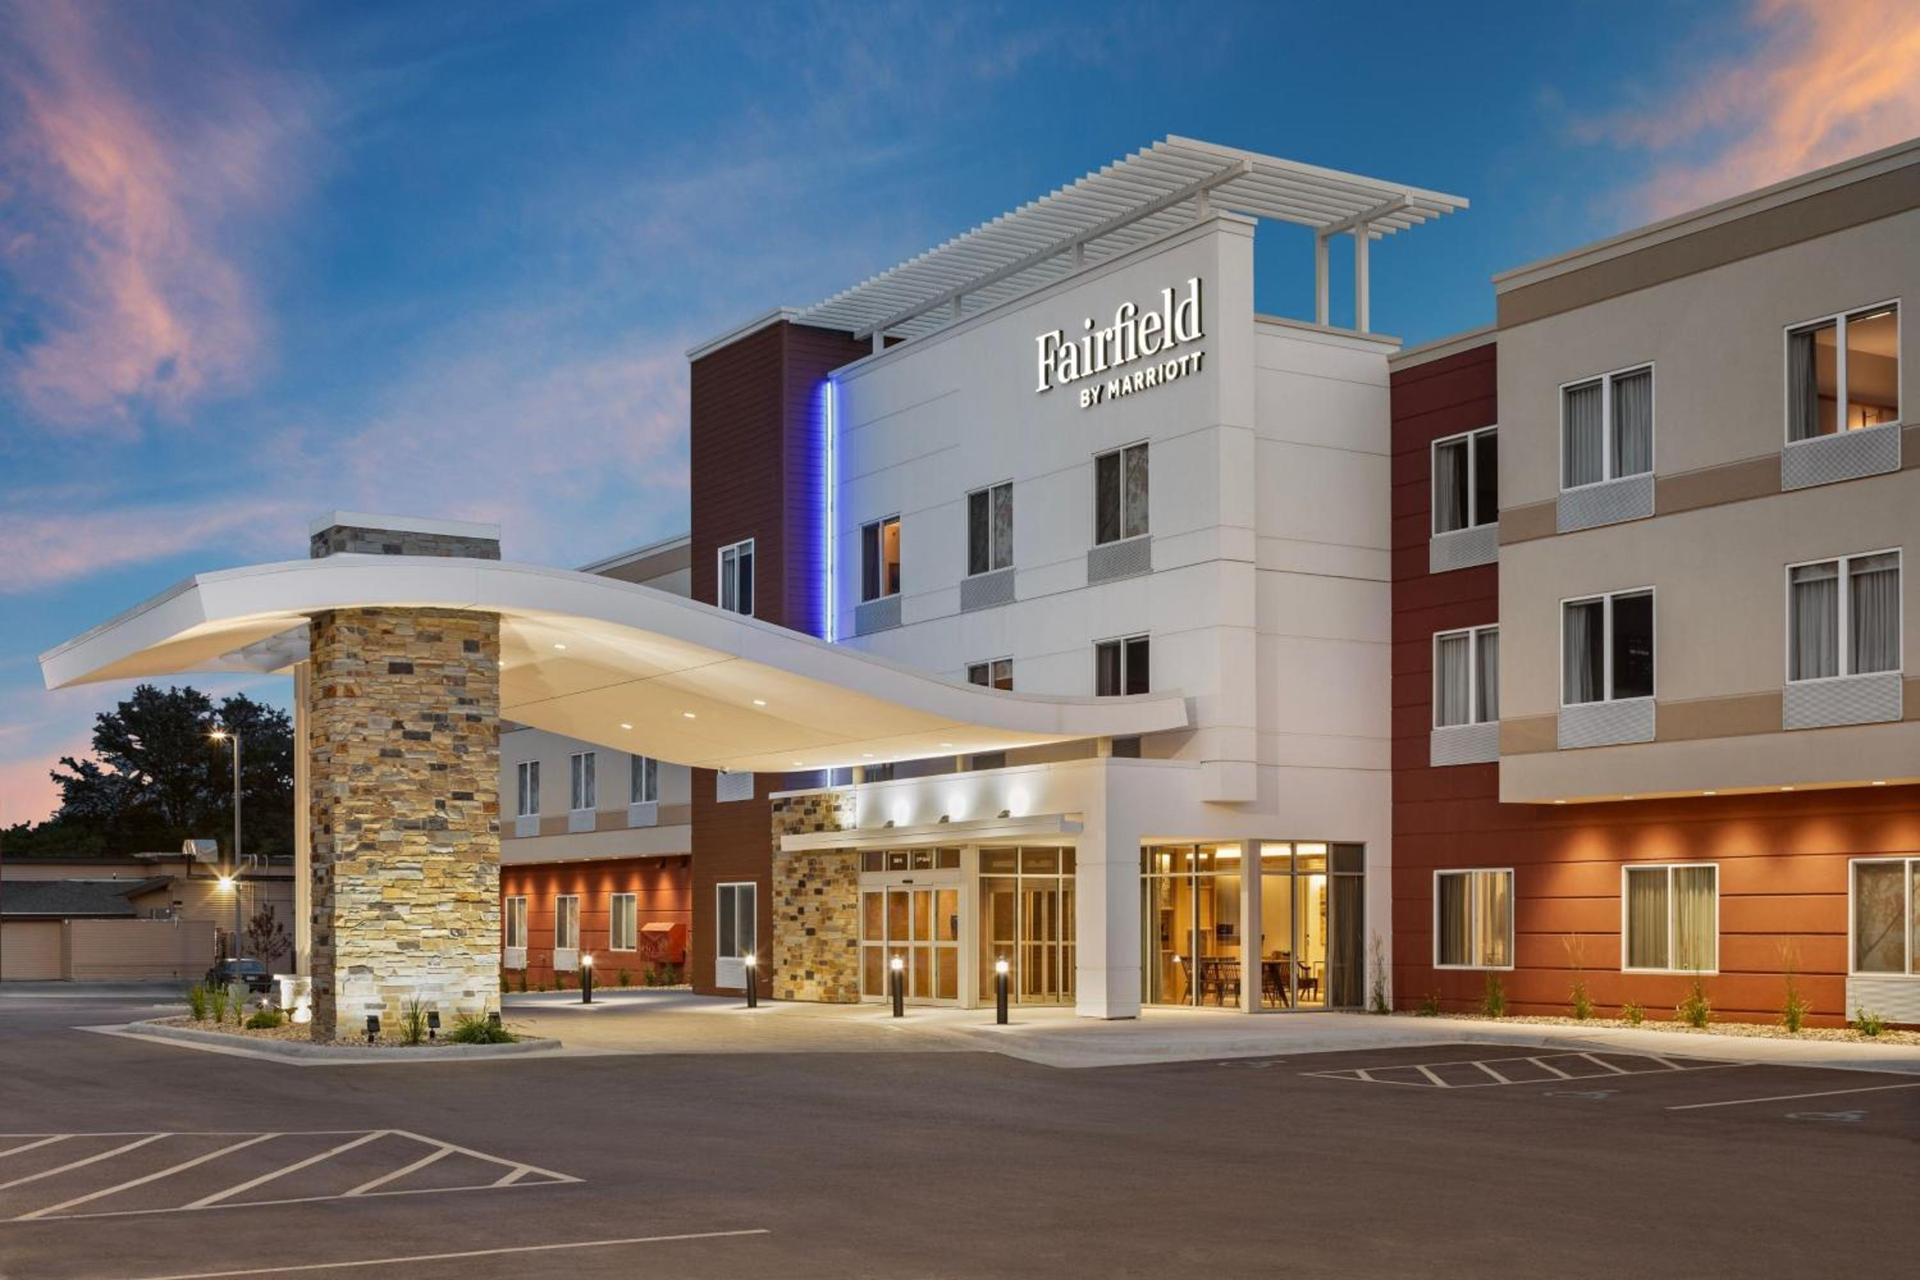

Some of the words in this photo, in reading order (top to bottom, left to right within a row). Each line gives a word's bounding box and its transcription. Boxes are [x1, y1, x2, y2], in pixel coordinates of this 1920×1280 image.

[1036, 277, 1204, 392] Fairfield
[1080, 385, 1103, 408] BY
[1107, 352, 1203, 399] MARRIOTT
